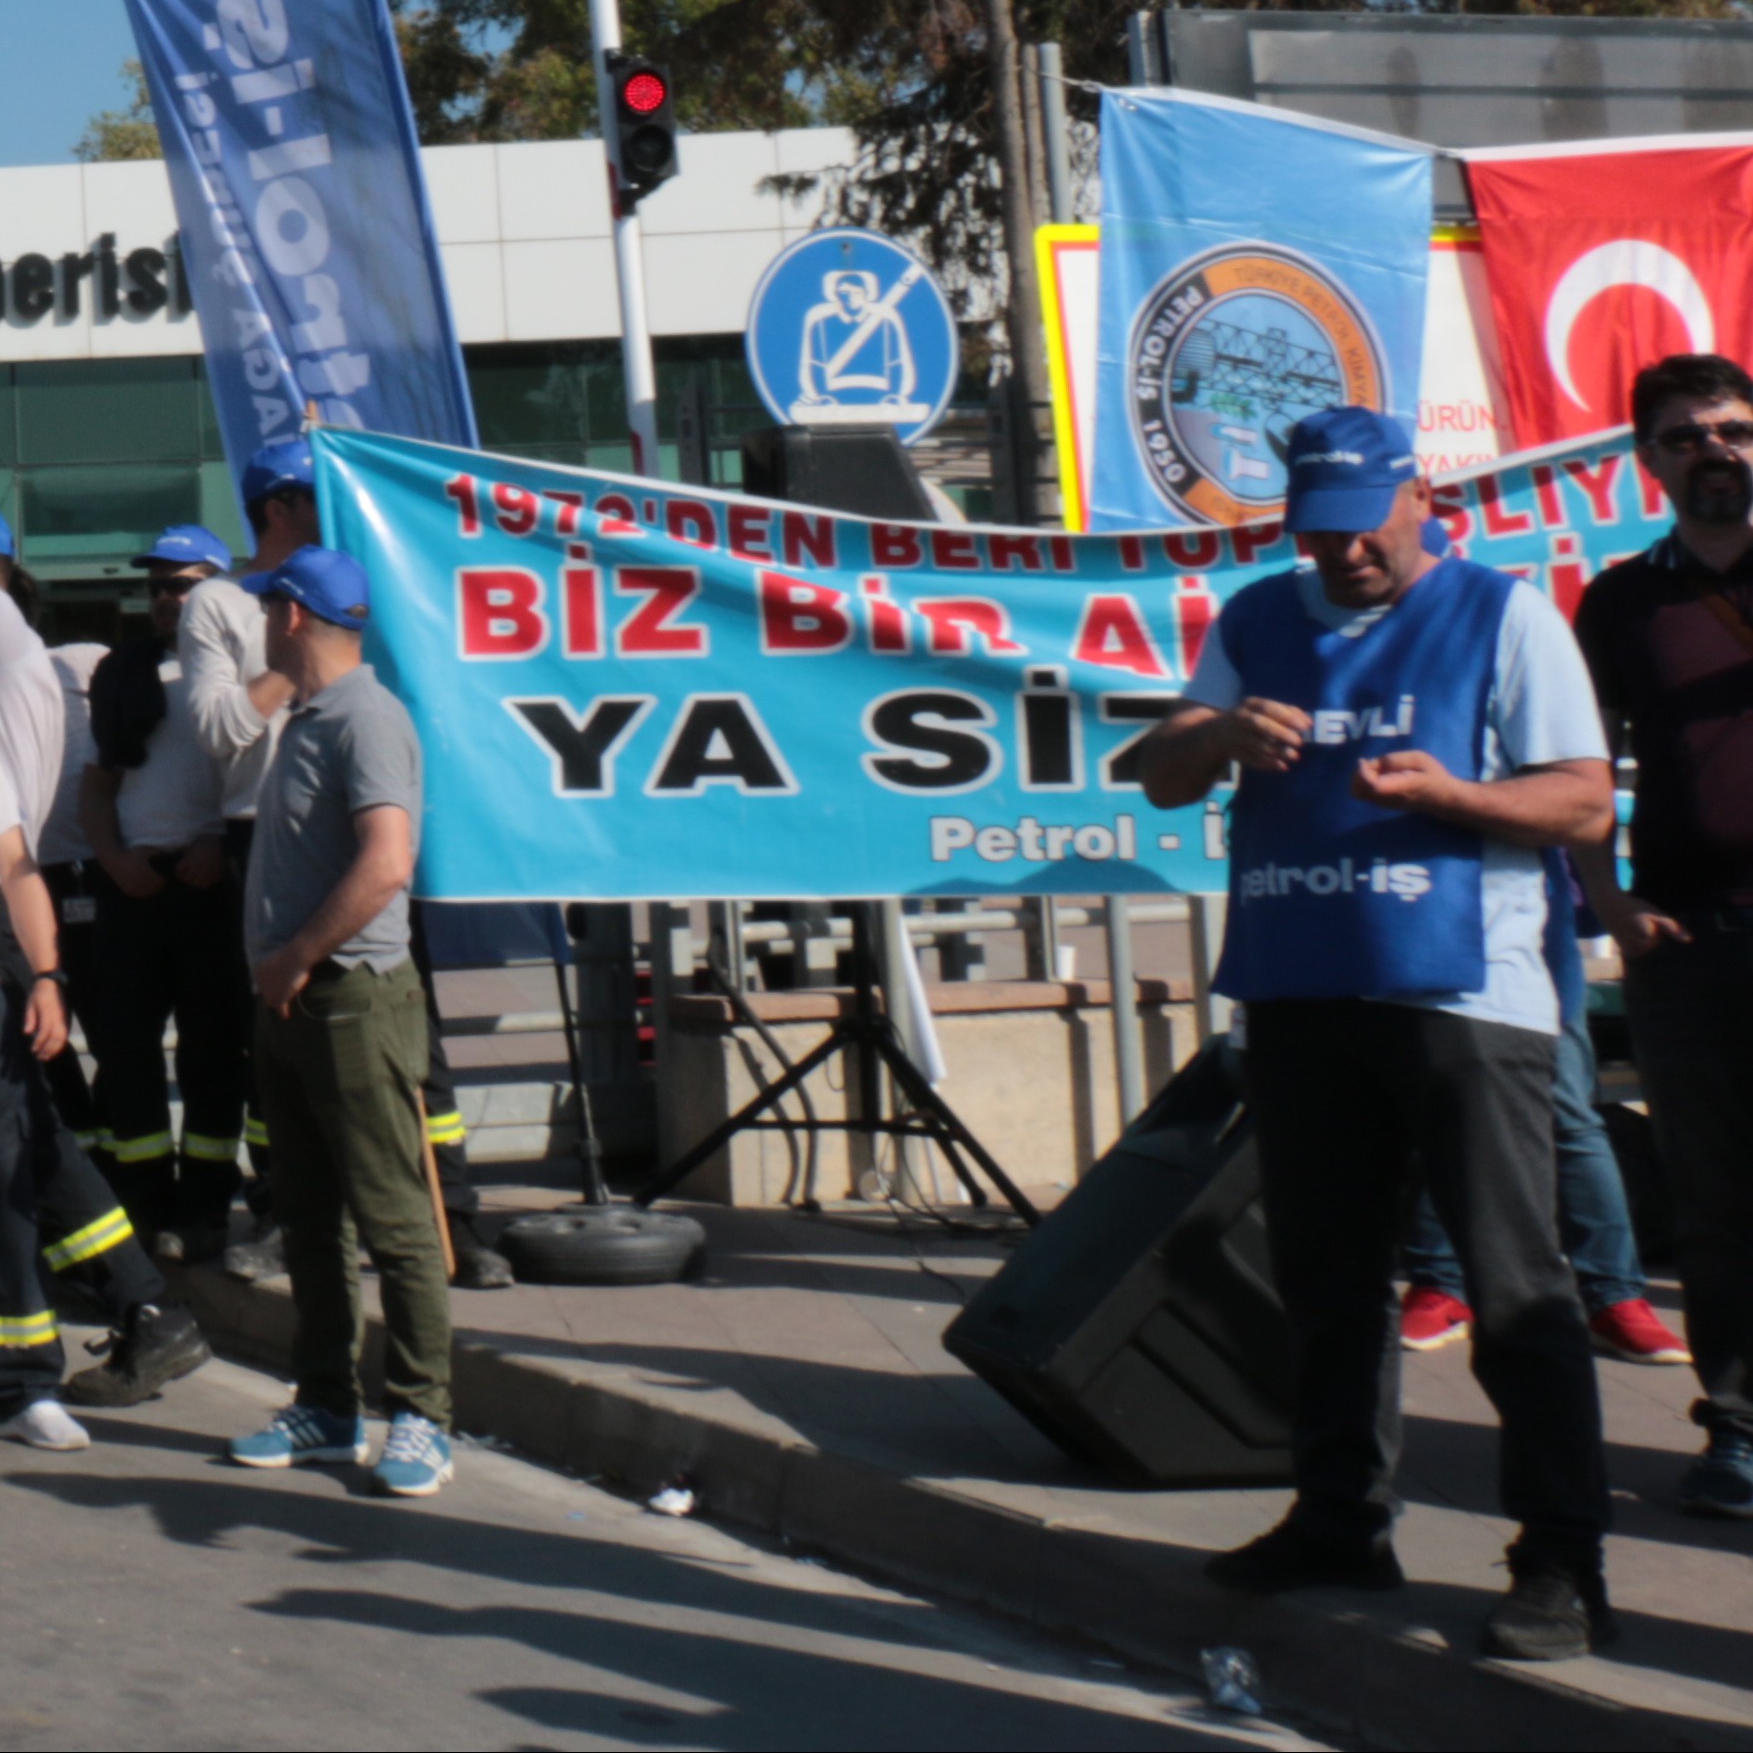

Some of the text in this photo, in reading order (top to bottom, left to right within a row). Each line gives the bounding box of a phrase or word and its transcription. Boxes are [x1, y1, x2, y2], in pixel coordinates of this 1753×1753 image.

[1142, 419, 1187, 484] 1950
[445, 473, 837, 570] 1972'DEN
[457, 542, 707, 658] BİZ
[757, 569, 1027, 654] BİR
[503, 692, 799, 796] YA
[1303, 694, 1415, 744] EVLİ
[930, 814, 1135, 862] Petrol
[1203, 801, 1231, 861] İ
